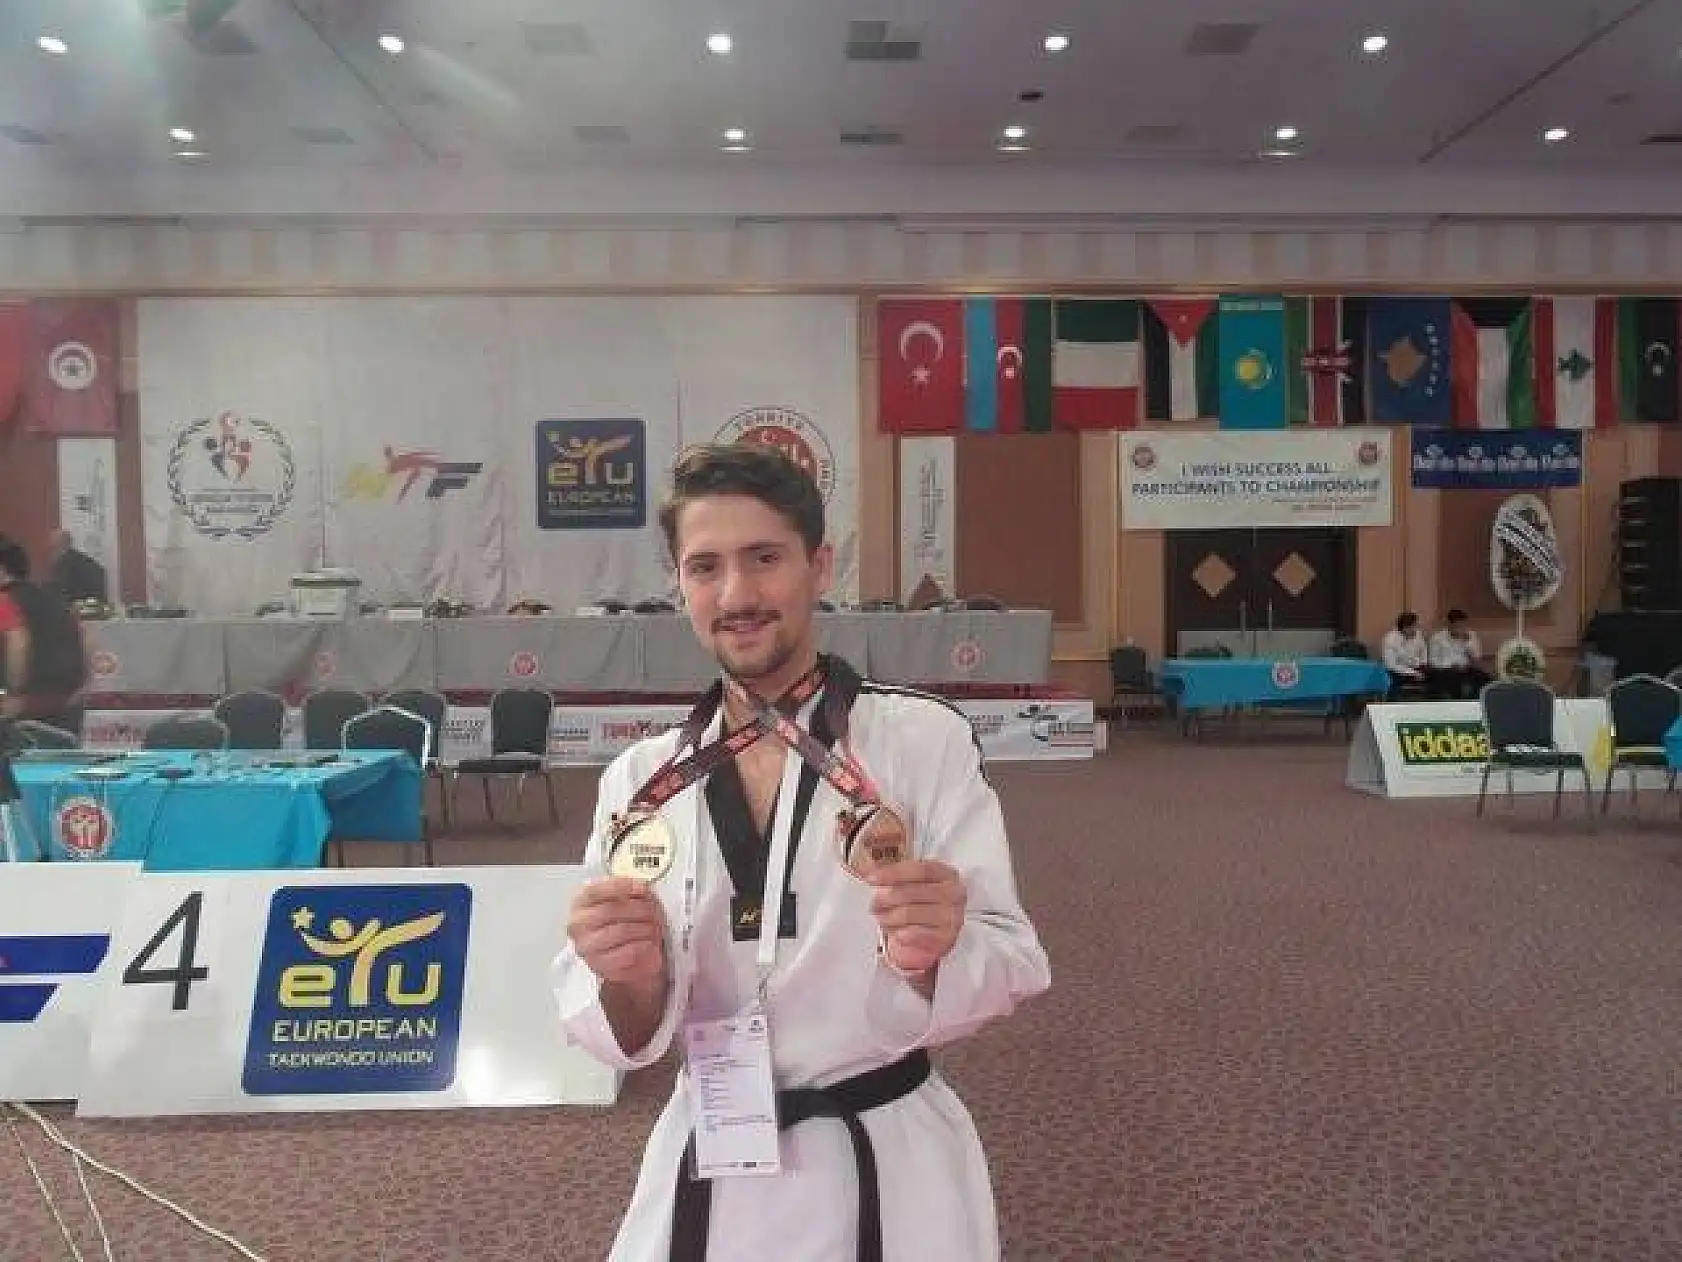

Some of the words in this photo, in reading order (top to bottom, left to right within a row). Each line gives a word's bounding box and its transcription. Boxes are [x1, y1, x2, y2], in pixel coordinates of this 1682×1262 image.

[1192, 462, 1231, 476] WISH
[1235, 462, 1301, 477] SUCCESS
[1132, 480, 1235, 495] PARTICIPANTS
[1239, 479, 1261, 493] TO
[1267, 478, 1380, 492] CHAMPIONSHIP
[122, 890, 209, 1011] 4
[271, 1017, 438, 1042] EUROPEAN
[267, 1051, 377, 1067] TAEKWONDO
[378, 1050, 435, 1064] UNION
